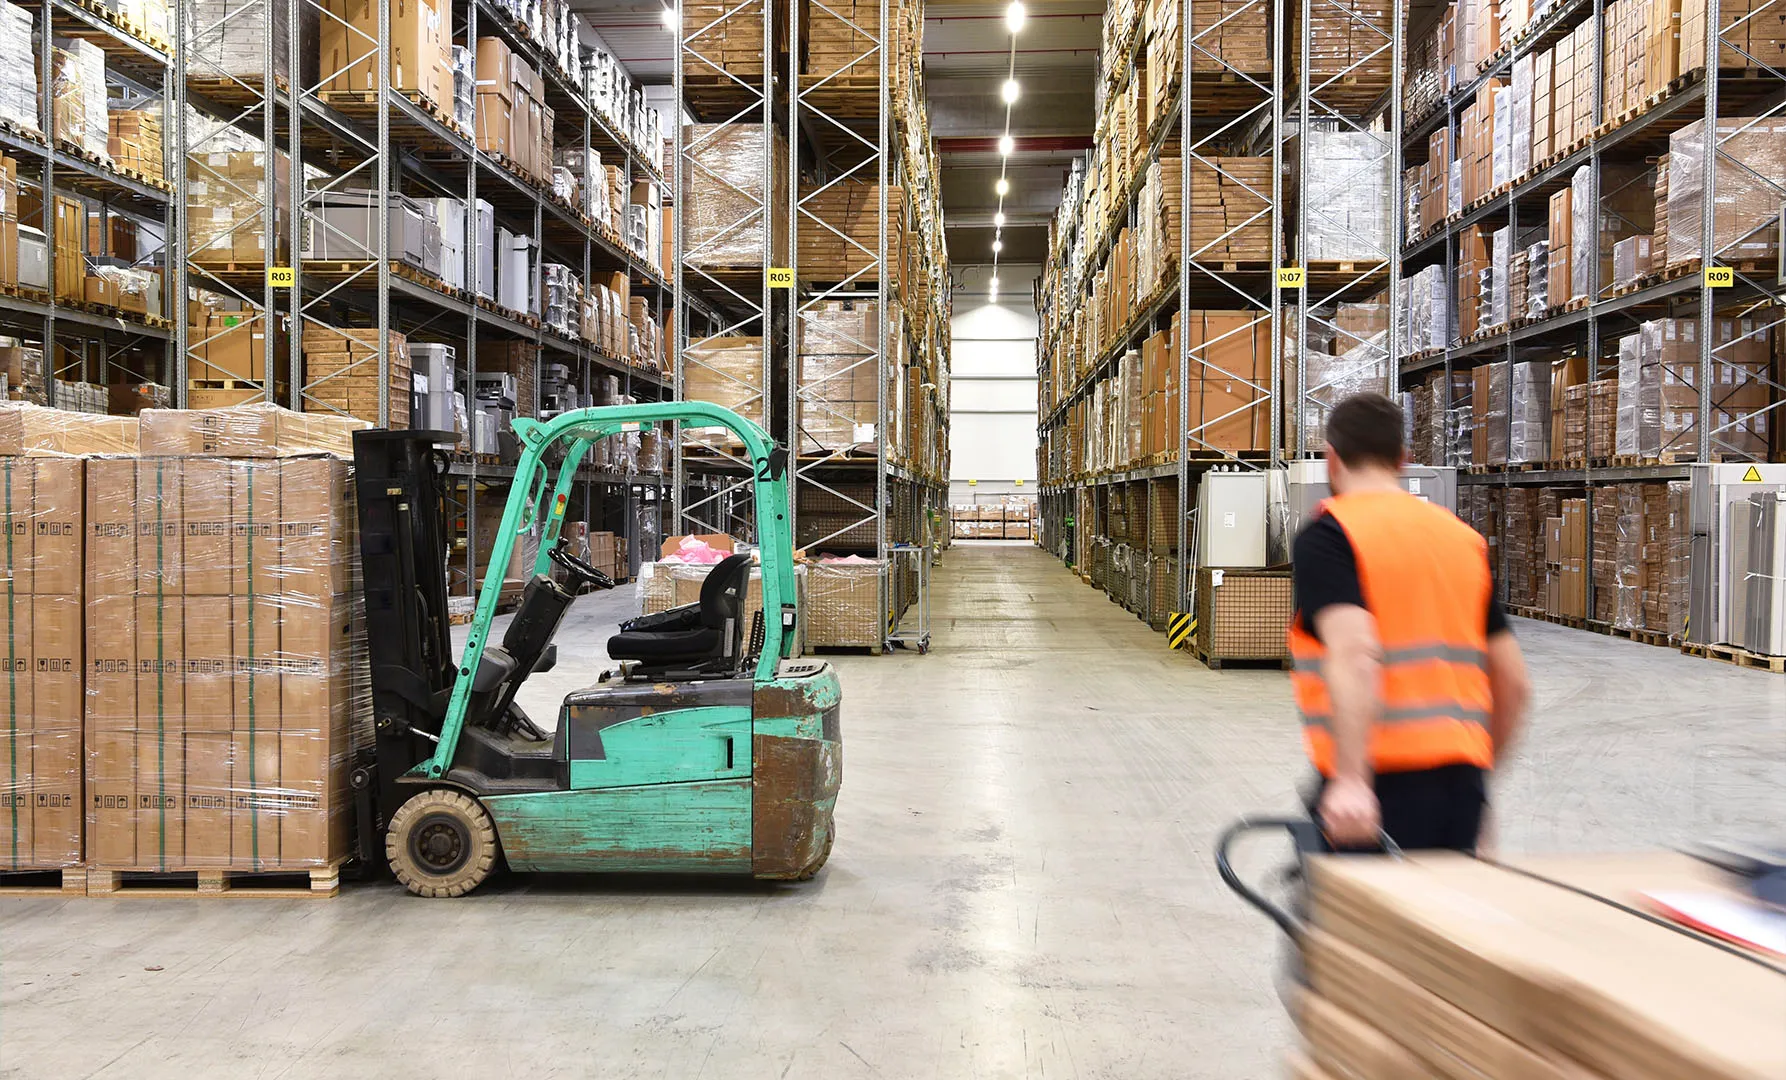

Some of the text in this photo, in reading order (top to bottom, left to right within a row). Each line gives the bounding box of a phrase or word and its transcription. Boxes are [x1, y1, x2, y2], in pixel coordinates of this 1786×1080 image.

[271, 272, 292, 281] R03
[770, 273, 791, 282] R05
[1279, 272, 1301, 282] R07
[1708, 272, 1730, 281] R09
[756, 457, 772, 482] 2
